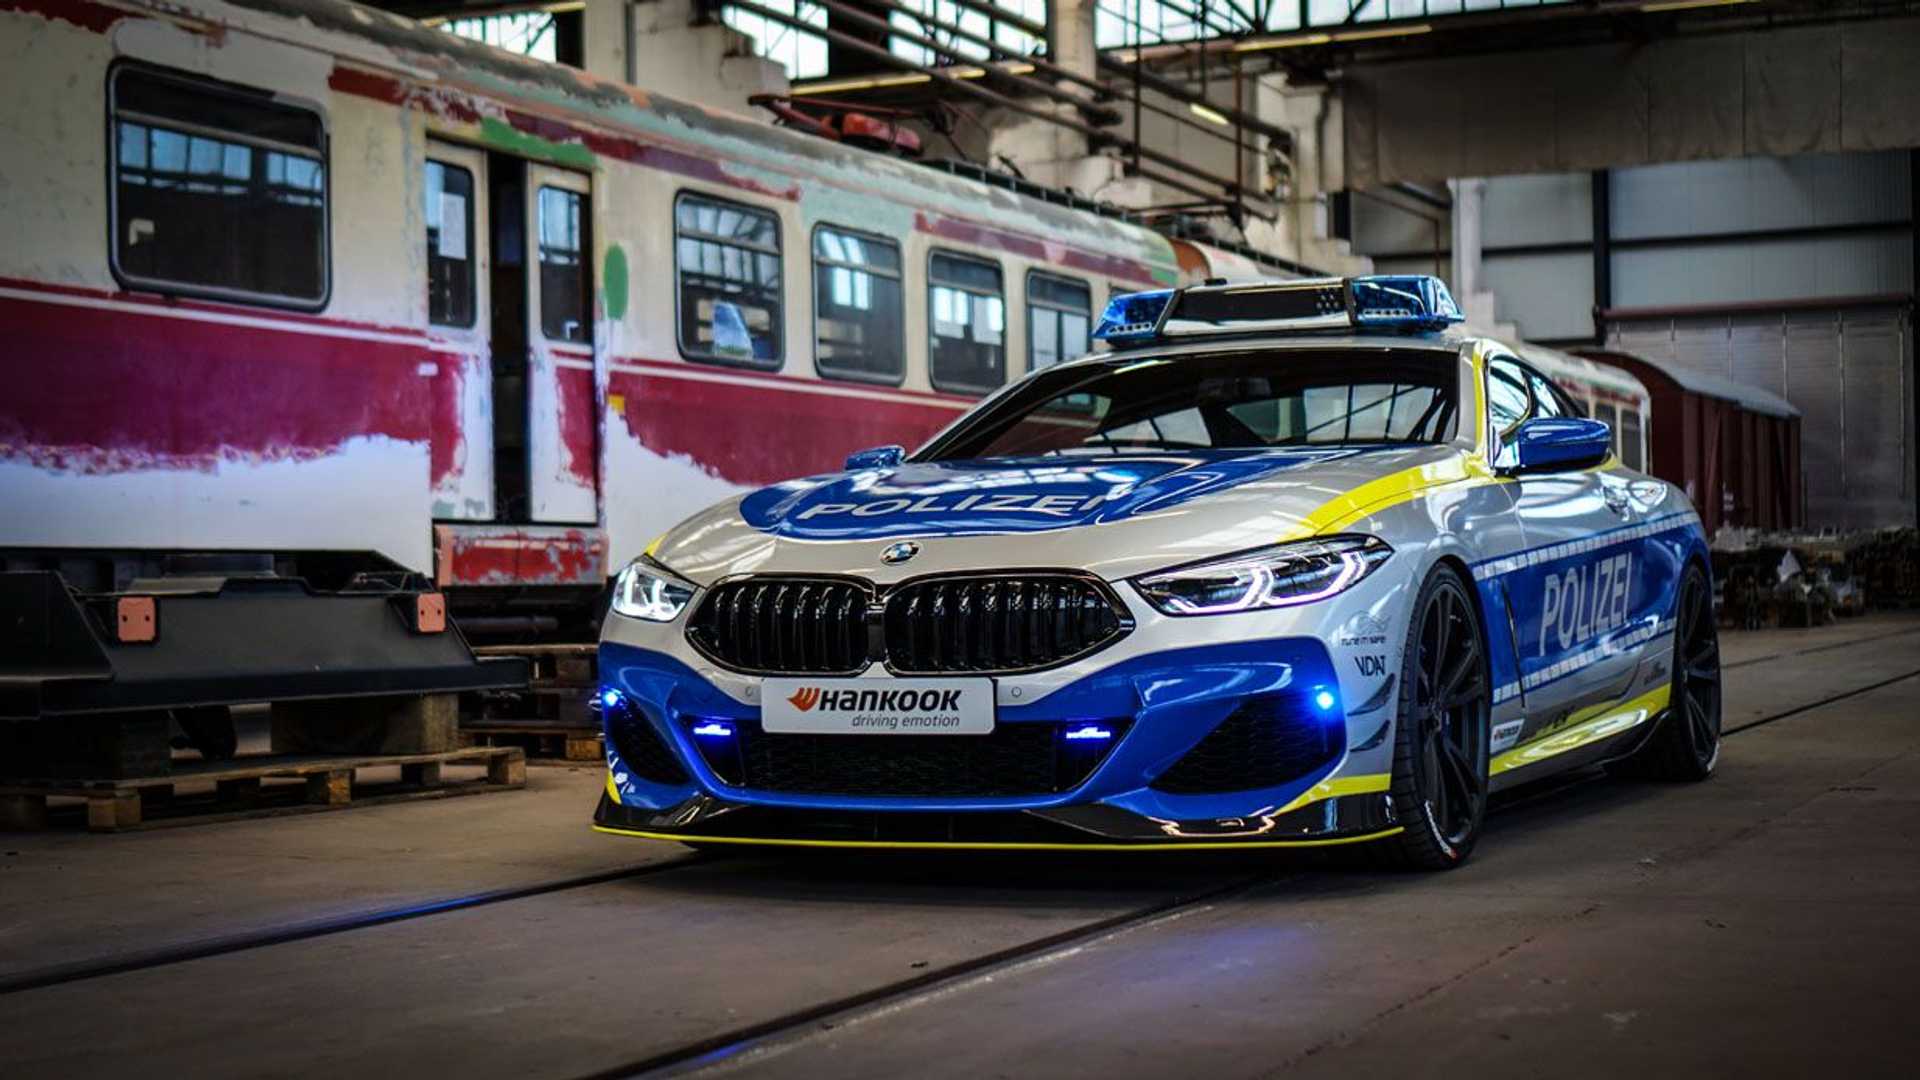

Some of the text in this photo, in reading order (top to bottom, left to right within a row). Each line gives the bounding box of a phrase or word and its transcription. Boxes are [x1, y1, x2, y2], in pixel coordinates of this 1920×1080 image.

[796, 494, 1106, 520] POLIZEI
[1540, 551, 1632, 657] POLIZEI
[852, 714, 960, 730] driving emotion
